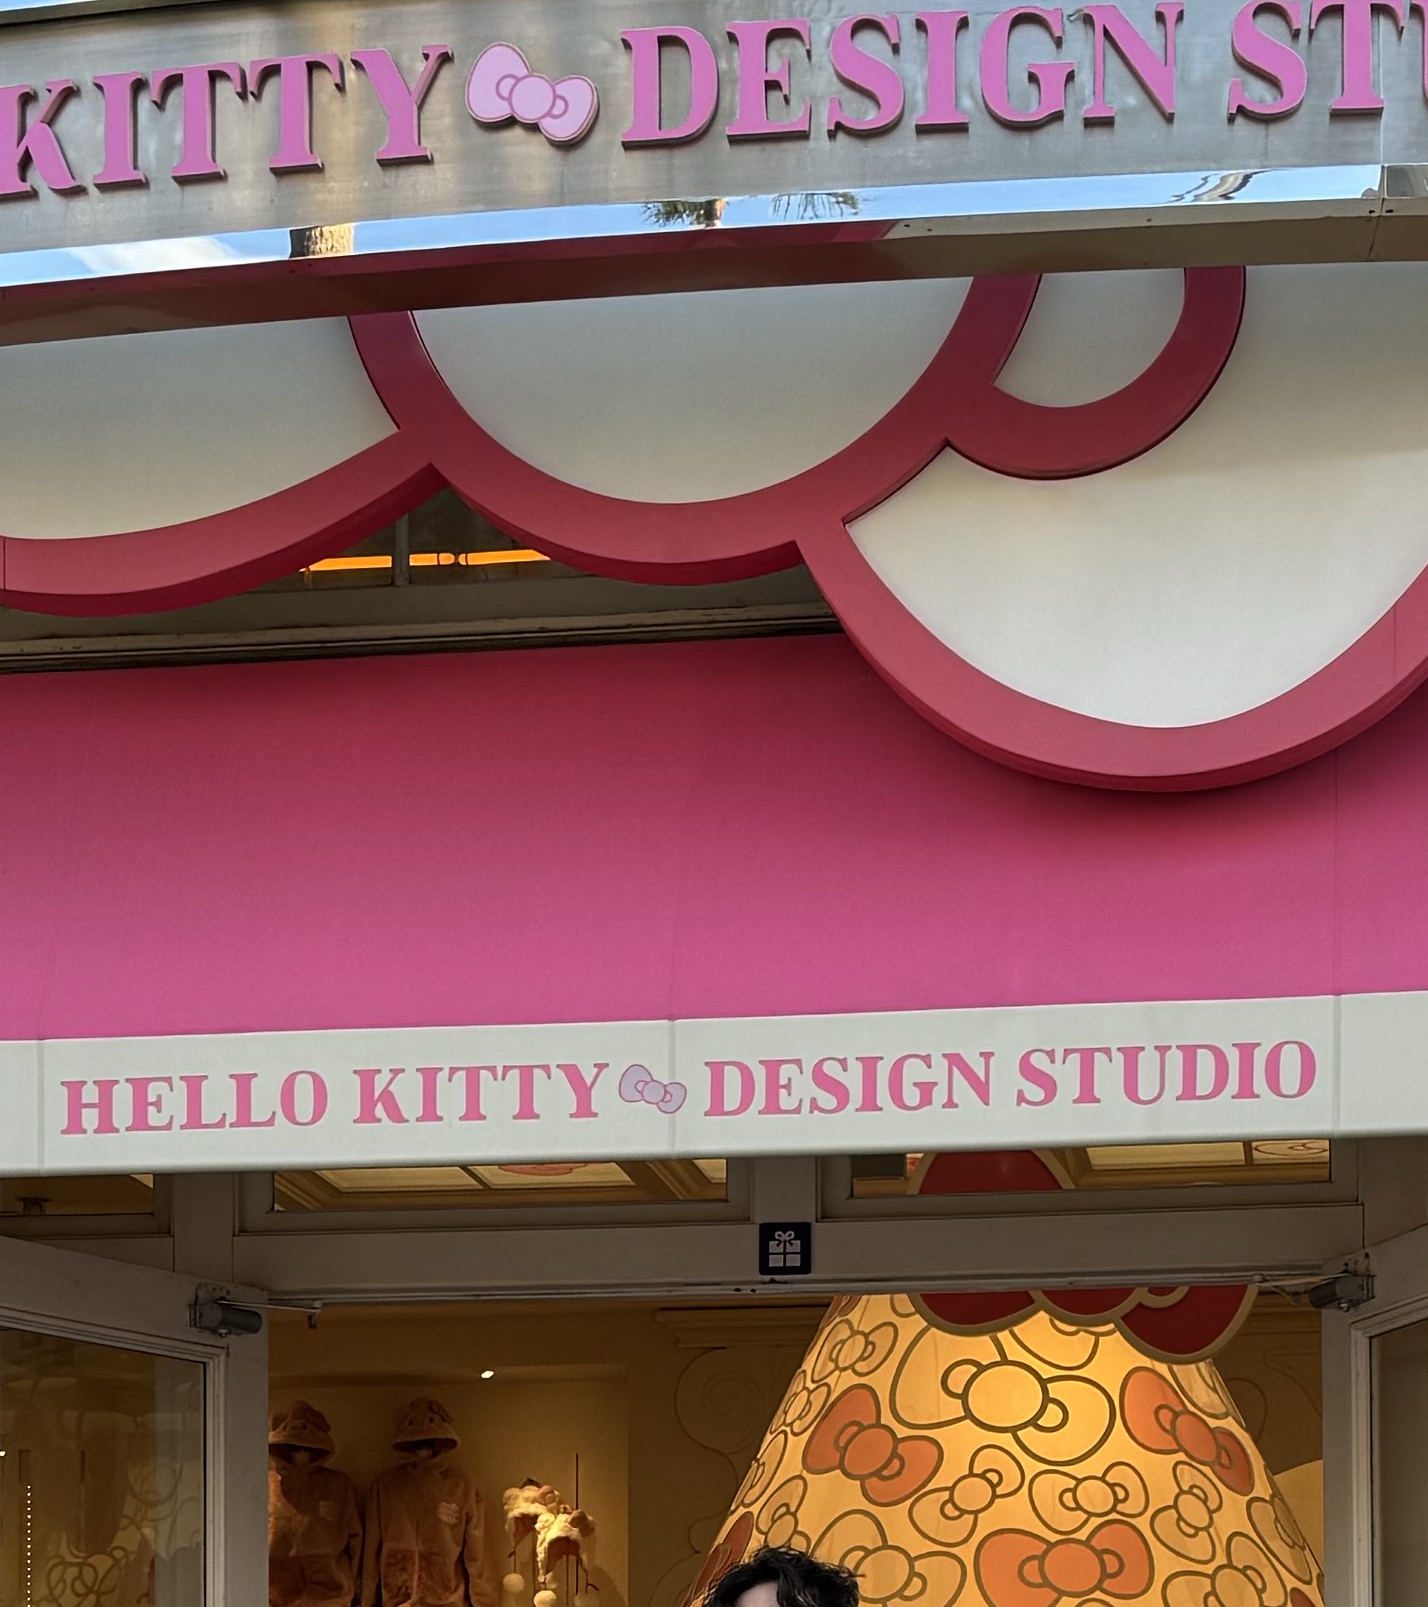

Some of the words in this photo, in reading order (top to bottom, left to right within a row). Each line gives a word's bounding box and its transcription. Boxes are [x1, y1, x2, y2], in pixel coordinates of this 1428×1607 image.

[619, 1, 1187, 147] DESIGN
[61, 1070, 329, 1136] HELLO
[353, 1062, 609, 1126] KITTY
[703, 1051, 995, 1118] DESIGN
[1015, 1040, 1318, 1108] STUDIO
